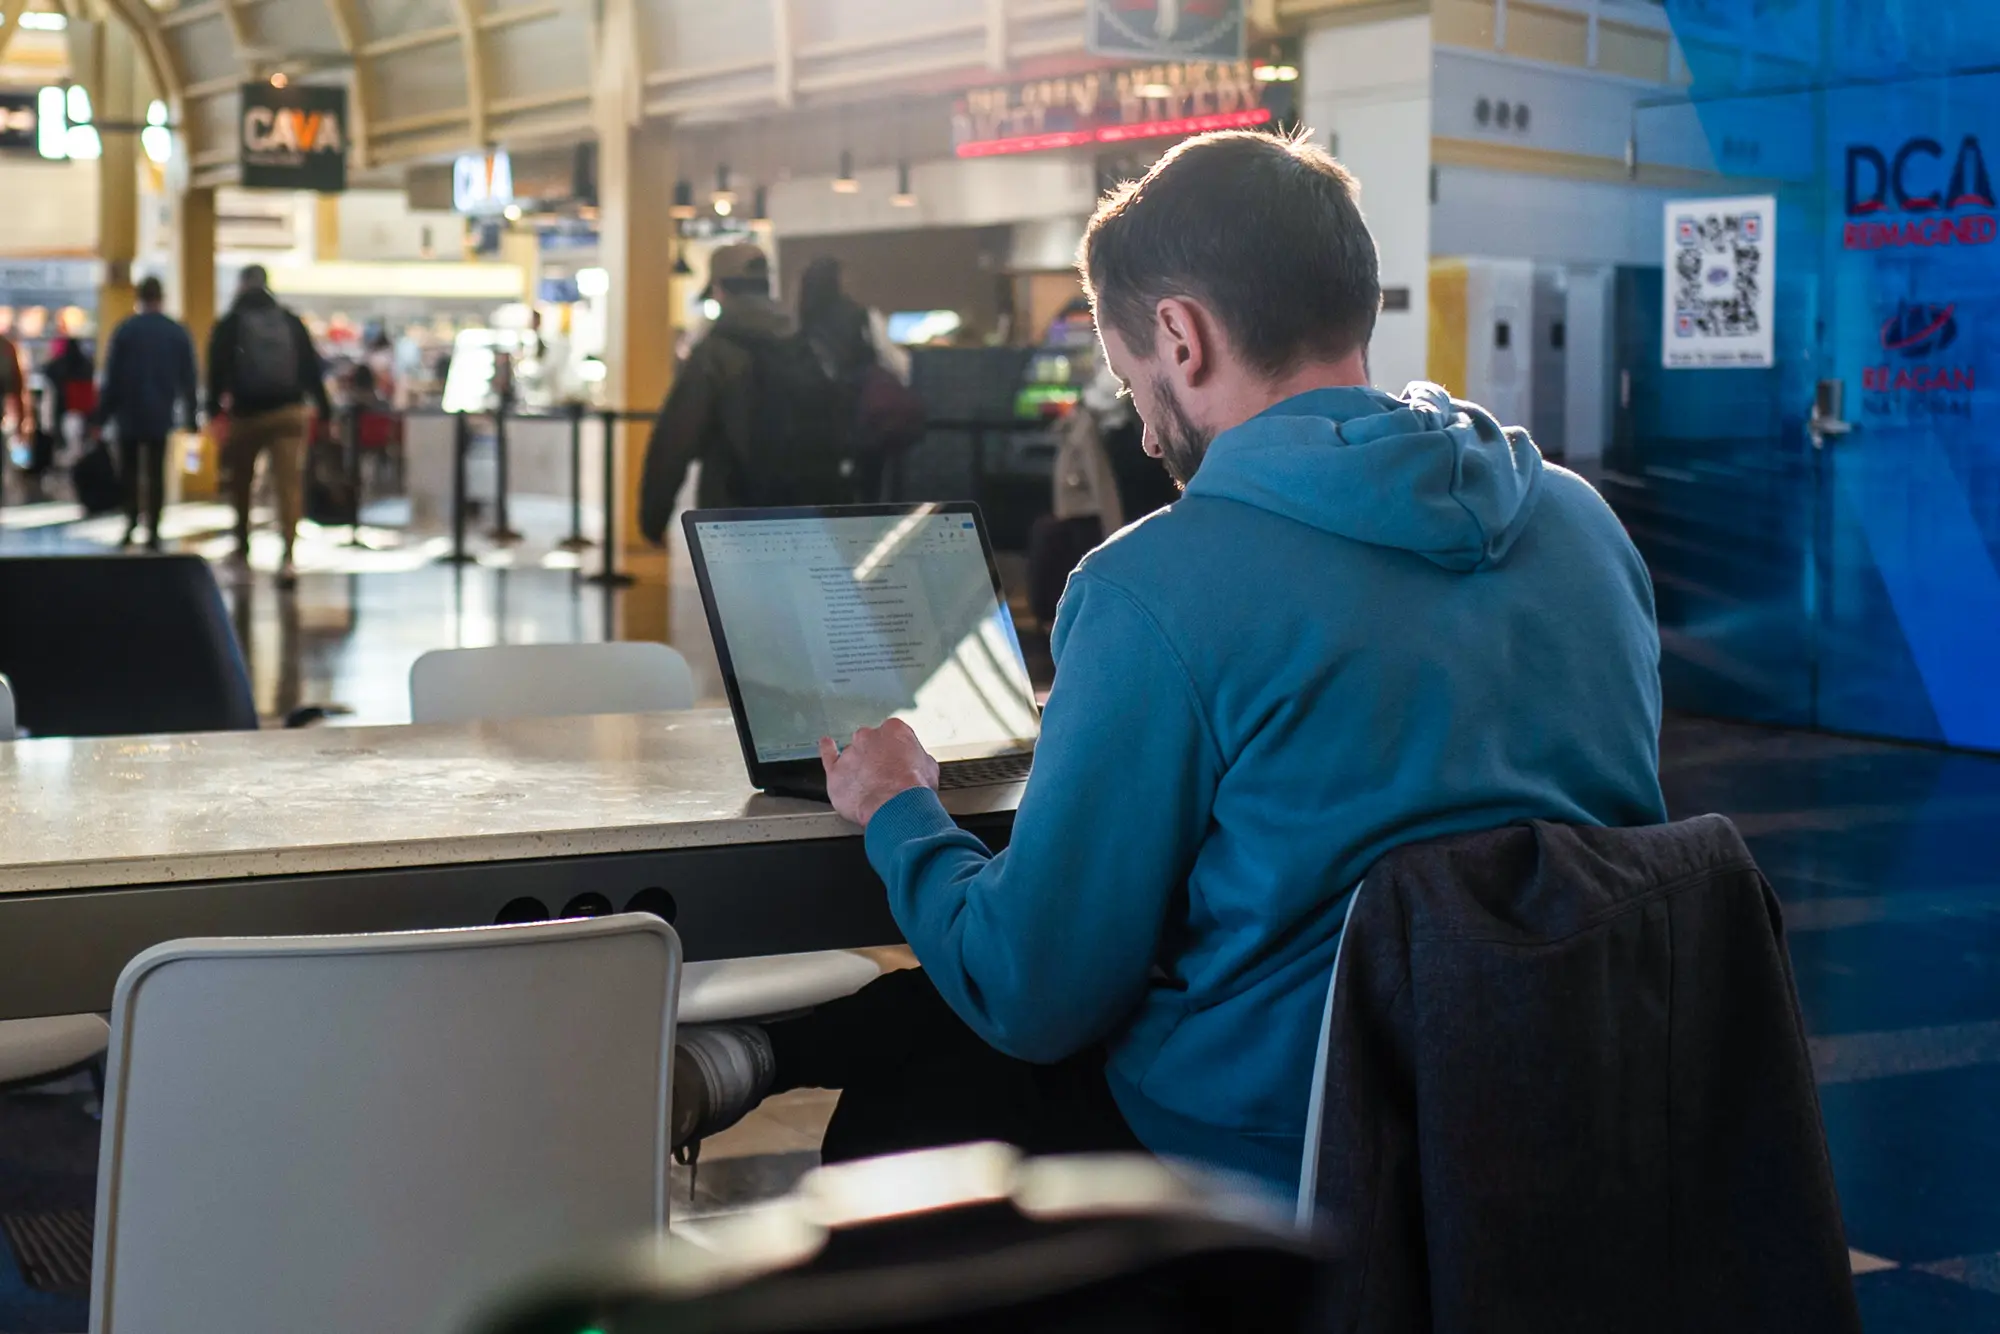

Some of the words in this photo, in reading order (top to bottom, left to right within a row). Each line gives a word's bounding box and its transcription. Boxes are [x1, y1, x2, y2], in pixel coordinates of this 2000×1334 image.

[244, 105, 341, 153] CAVA
[1845, 133, 1996, 216] DCA
[1844, 214, 1997, 250] REIMAGINED
[1862, 365, 1975, 393] REAGAN
